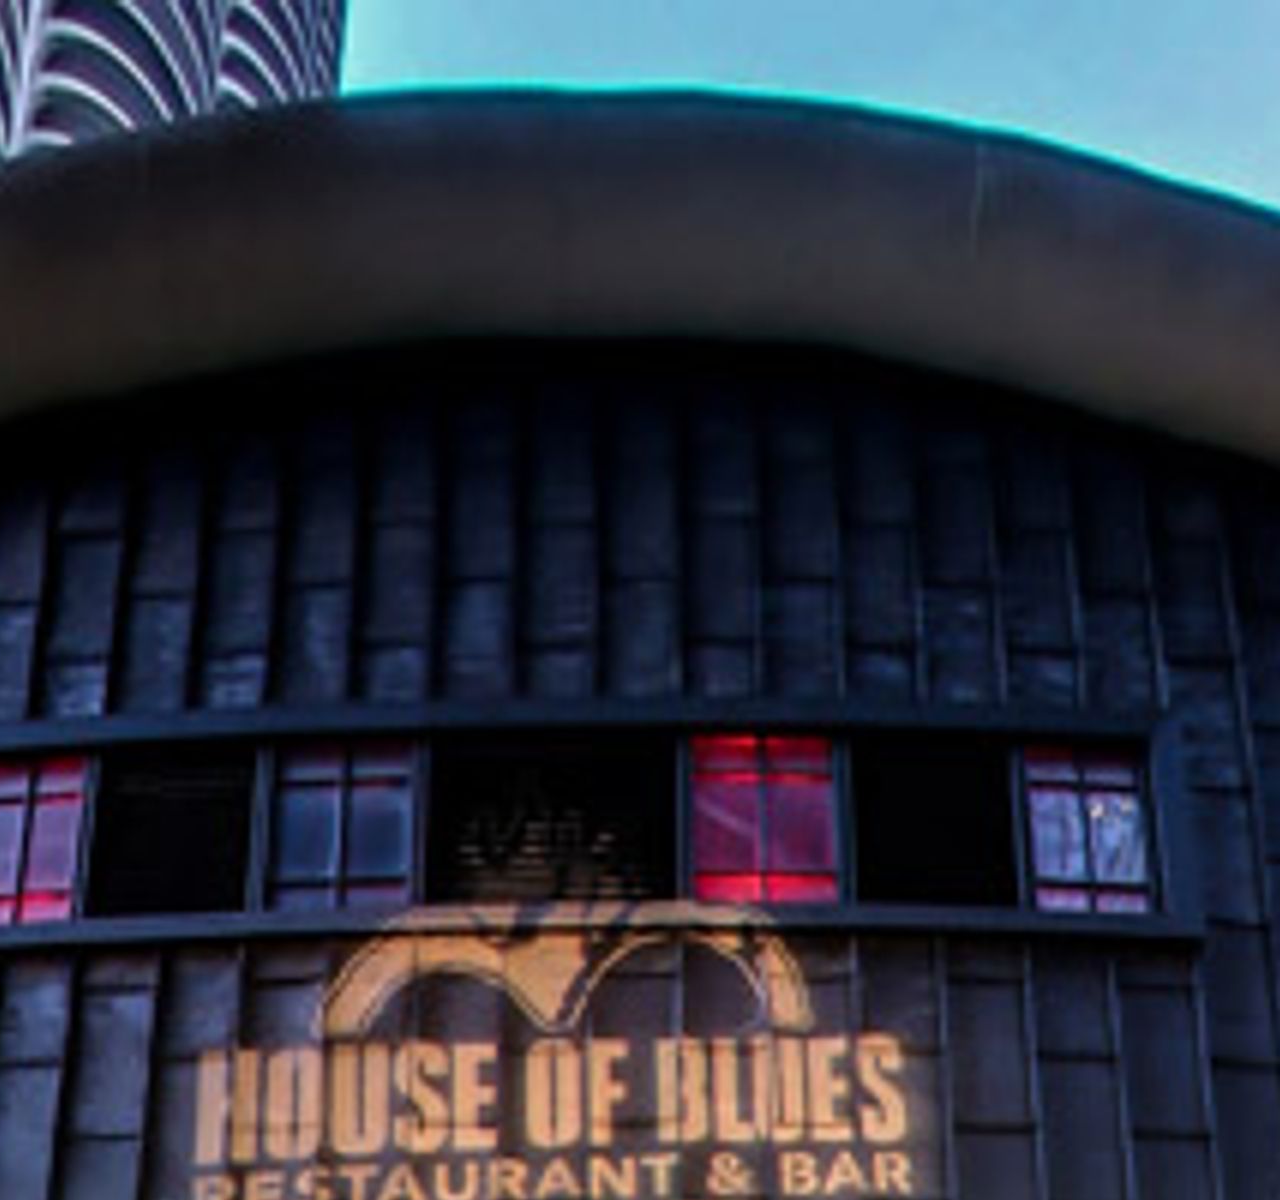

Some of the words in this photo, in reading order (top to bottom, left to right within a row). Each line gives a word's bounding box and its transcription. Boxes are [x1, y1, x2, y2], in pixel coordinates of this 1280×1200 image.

[193, 1044, 498, 1165] HOUSE
[525, 1040, 627, 1146] OF
[658, 1034, 905, 1143] BLUES
[707, 1159, 756, 1196] &
[782, 1151, 914, 1197] BAR
